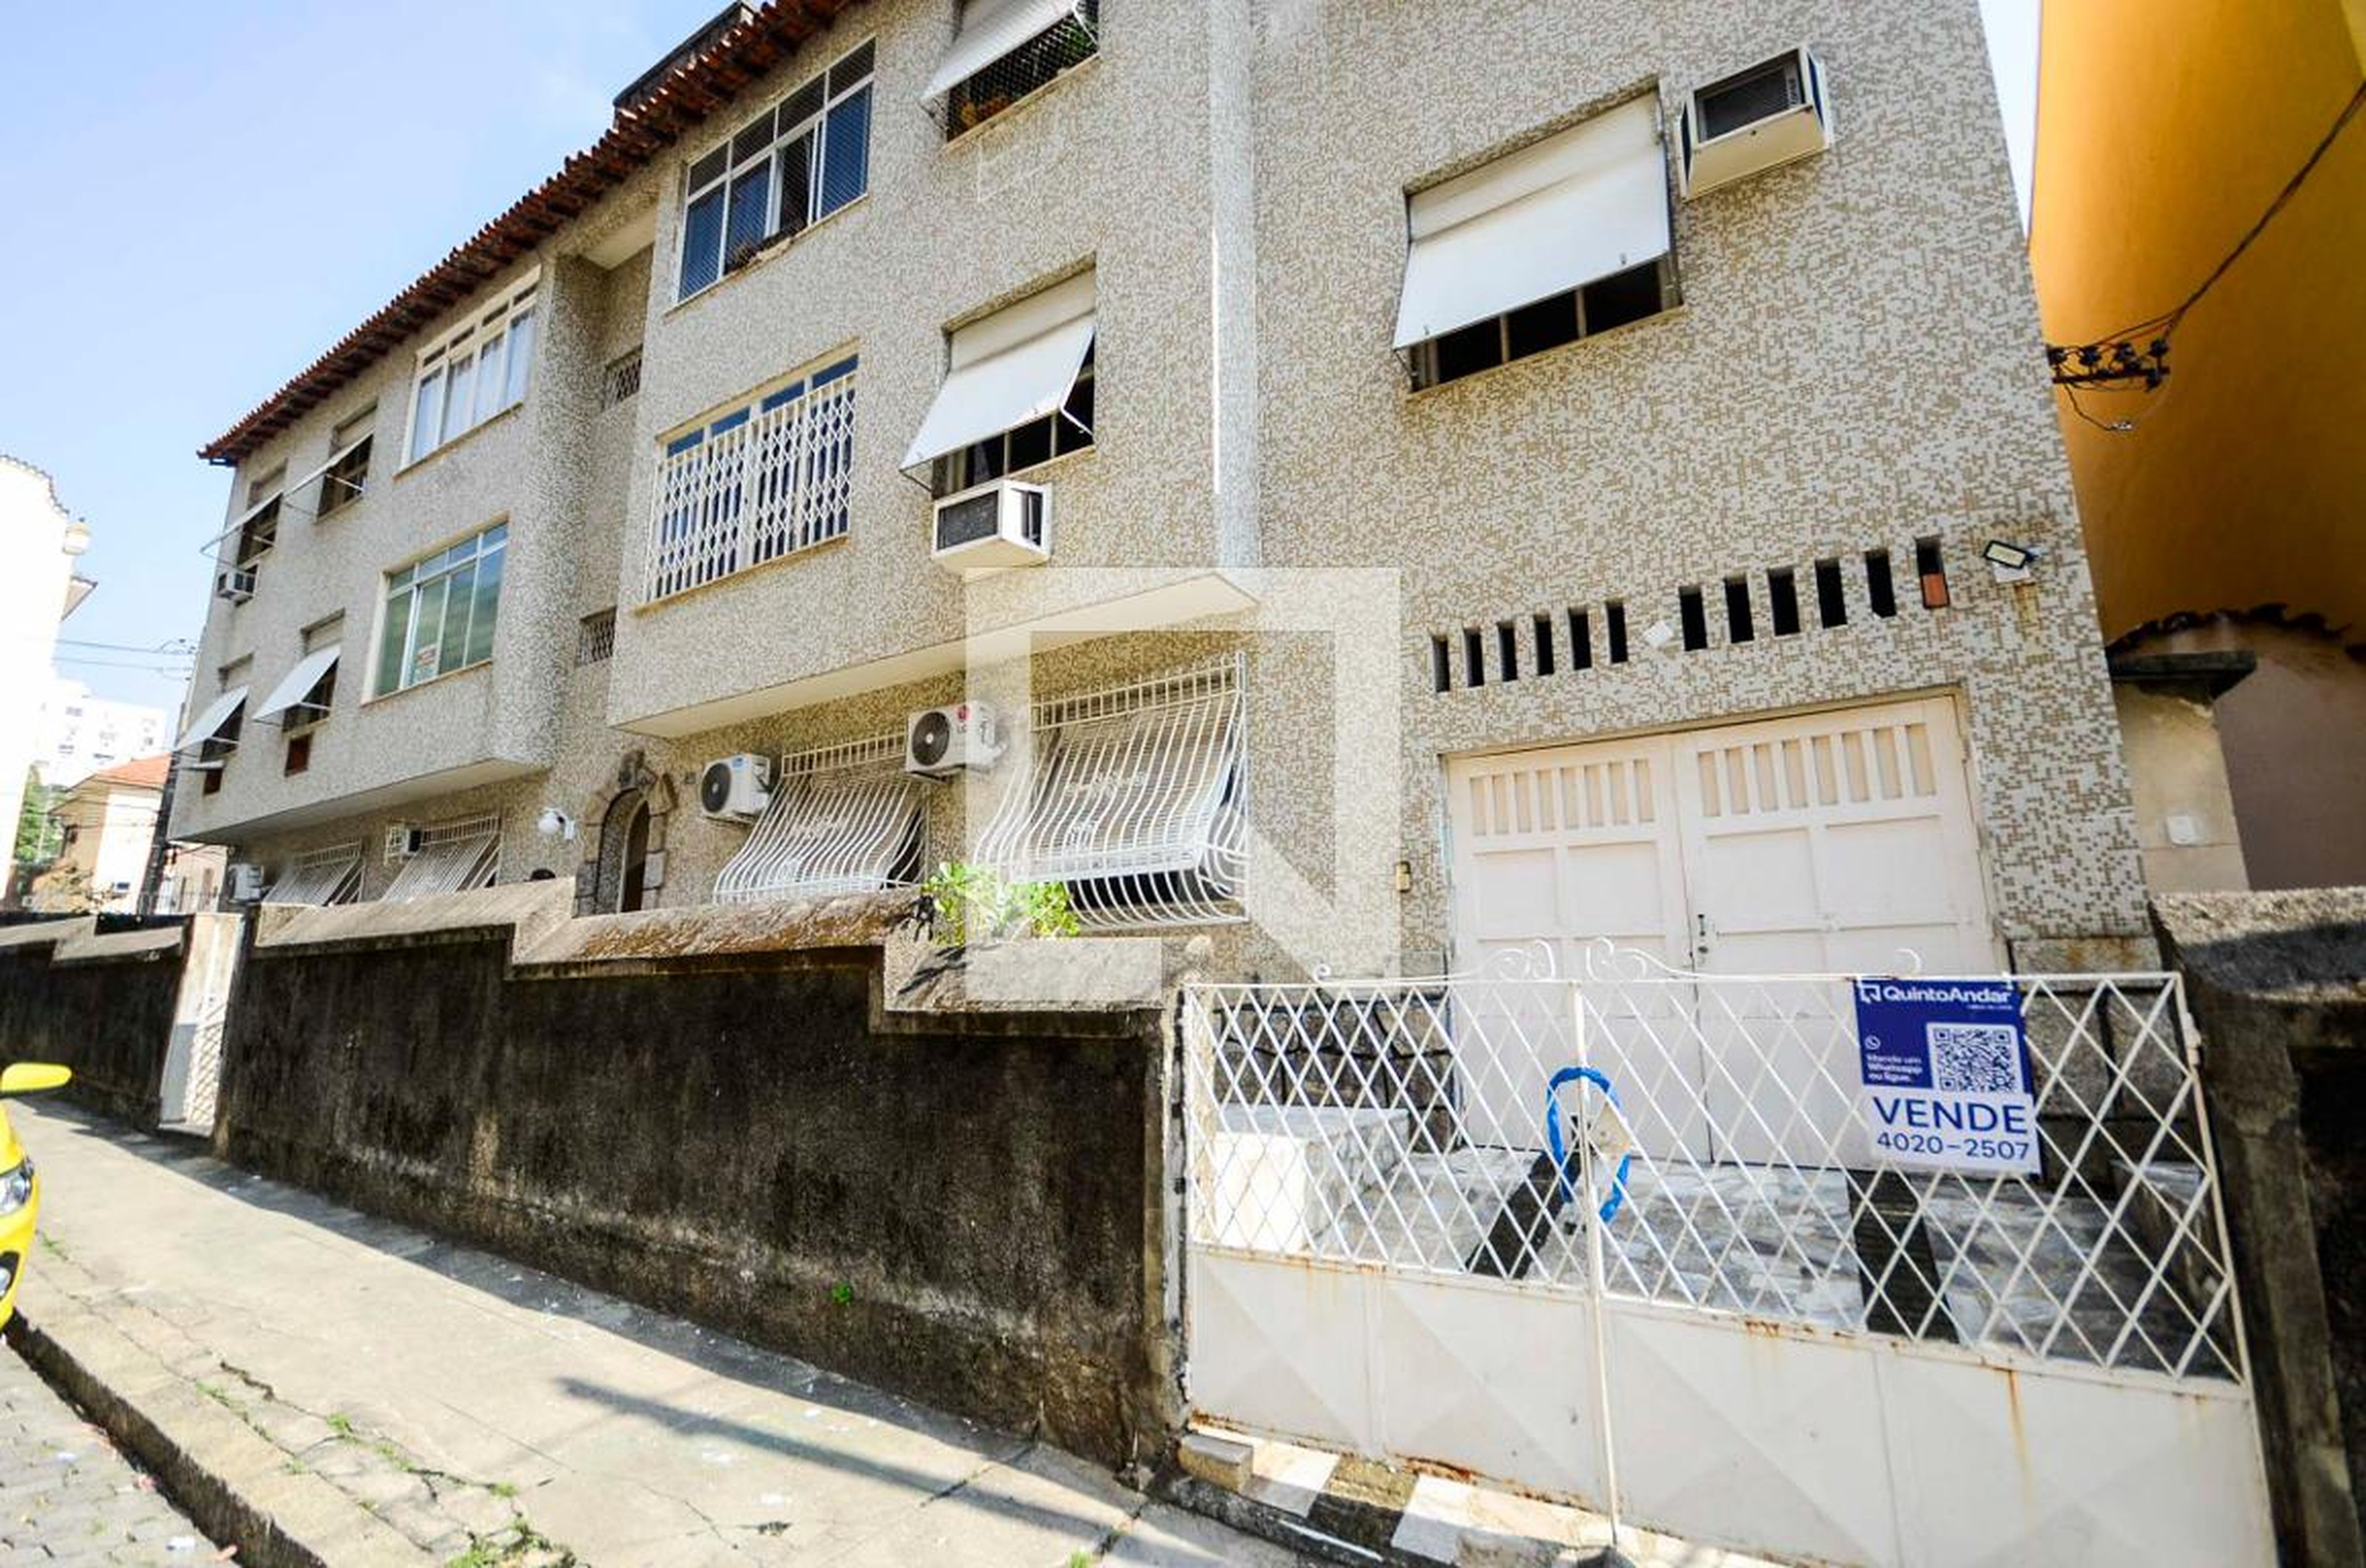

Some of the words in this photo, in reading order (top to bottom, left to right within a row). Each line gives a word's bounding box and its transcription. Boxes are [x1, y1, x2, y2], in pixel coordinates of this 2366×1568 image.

[1883, 987, 2012, 1003] QuintoAndar
[1873, 1097, 2028, 1134] VENDE
[1877, 1132, 2029, 1160] 4020-2507
